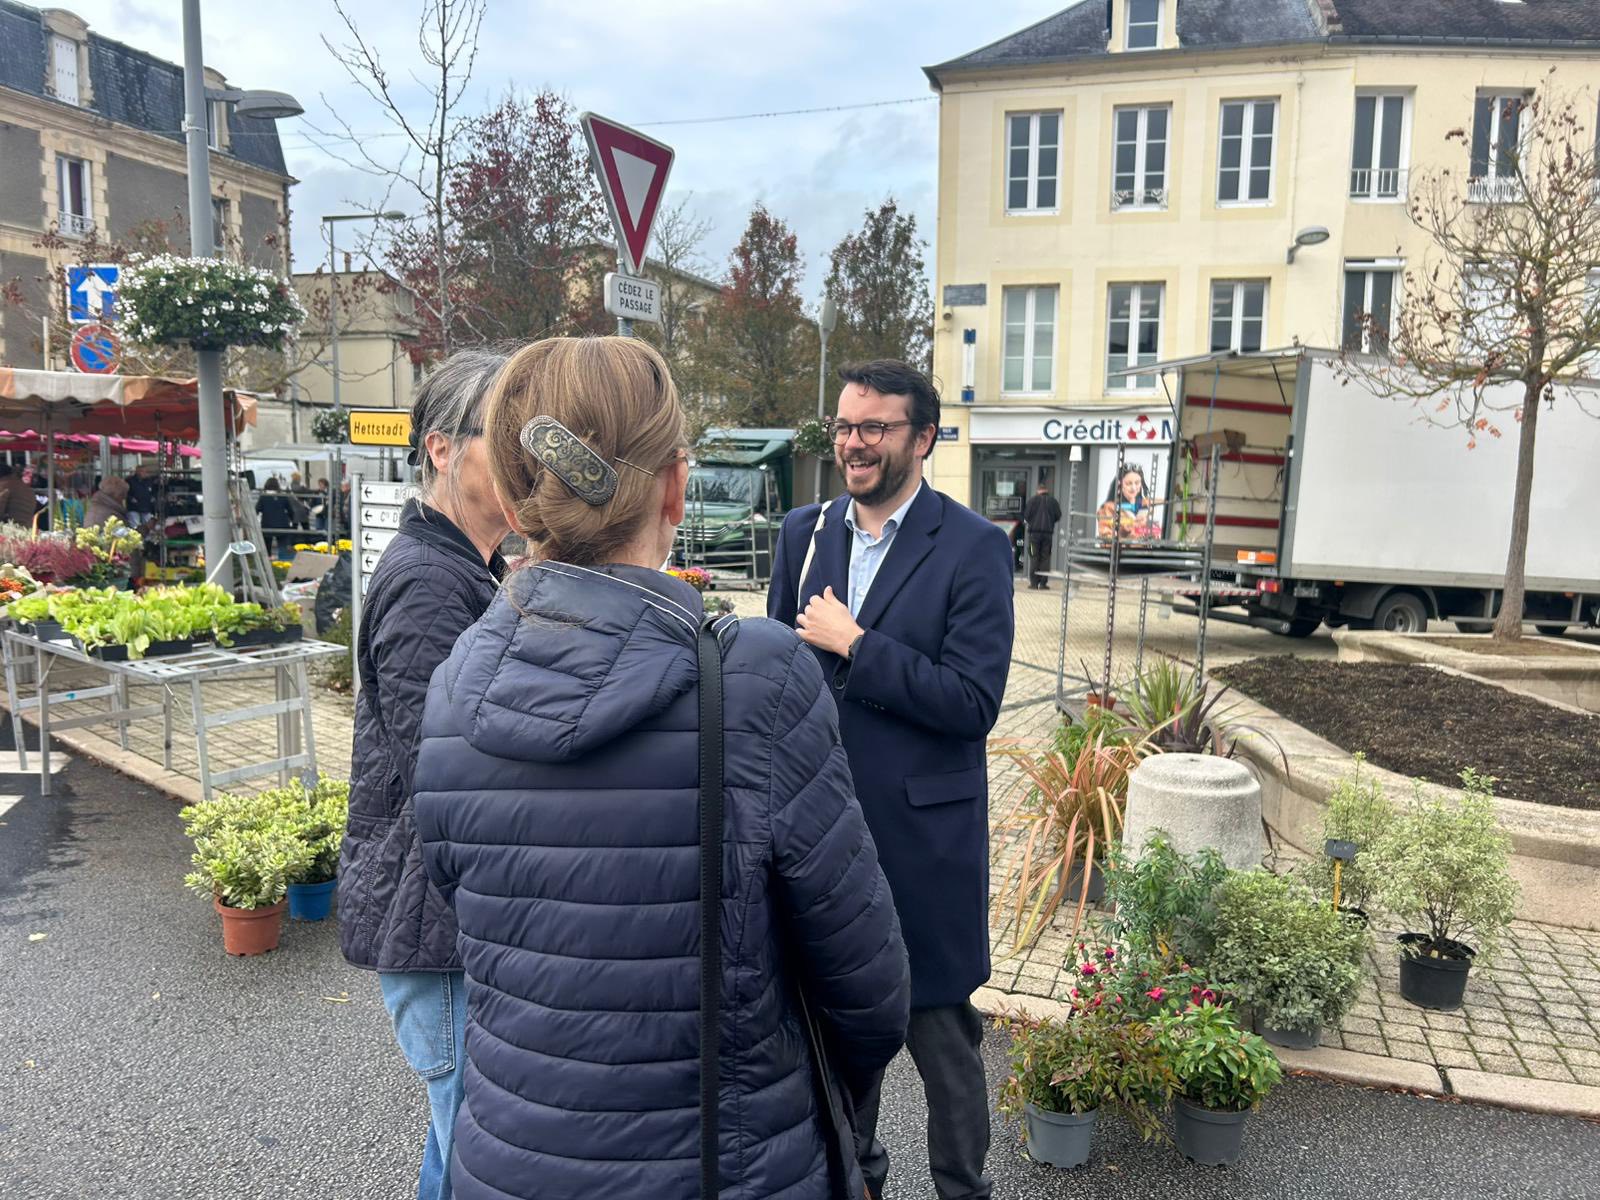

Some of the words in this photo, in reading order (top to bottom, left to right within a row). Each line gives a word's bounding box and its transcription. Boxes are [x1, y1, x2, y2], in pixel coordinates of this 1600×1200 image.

[618, 281, 642, 298] CÉDEZ
[645, 289, 654, 301] LE
[620, 297, 653, 314] PASSAGE
[353, 421, 404, 436] Hettstadt
[1043, 418, 1123, 441] Crédit
